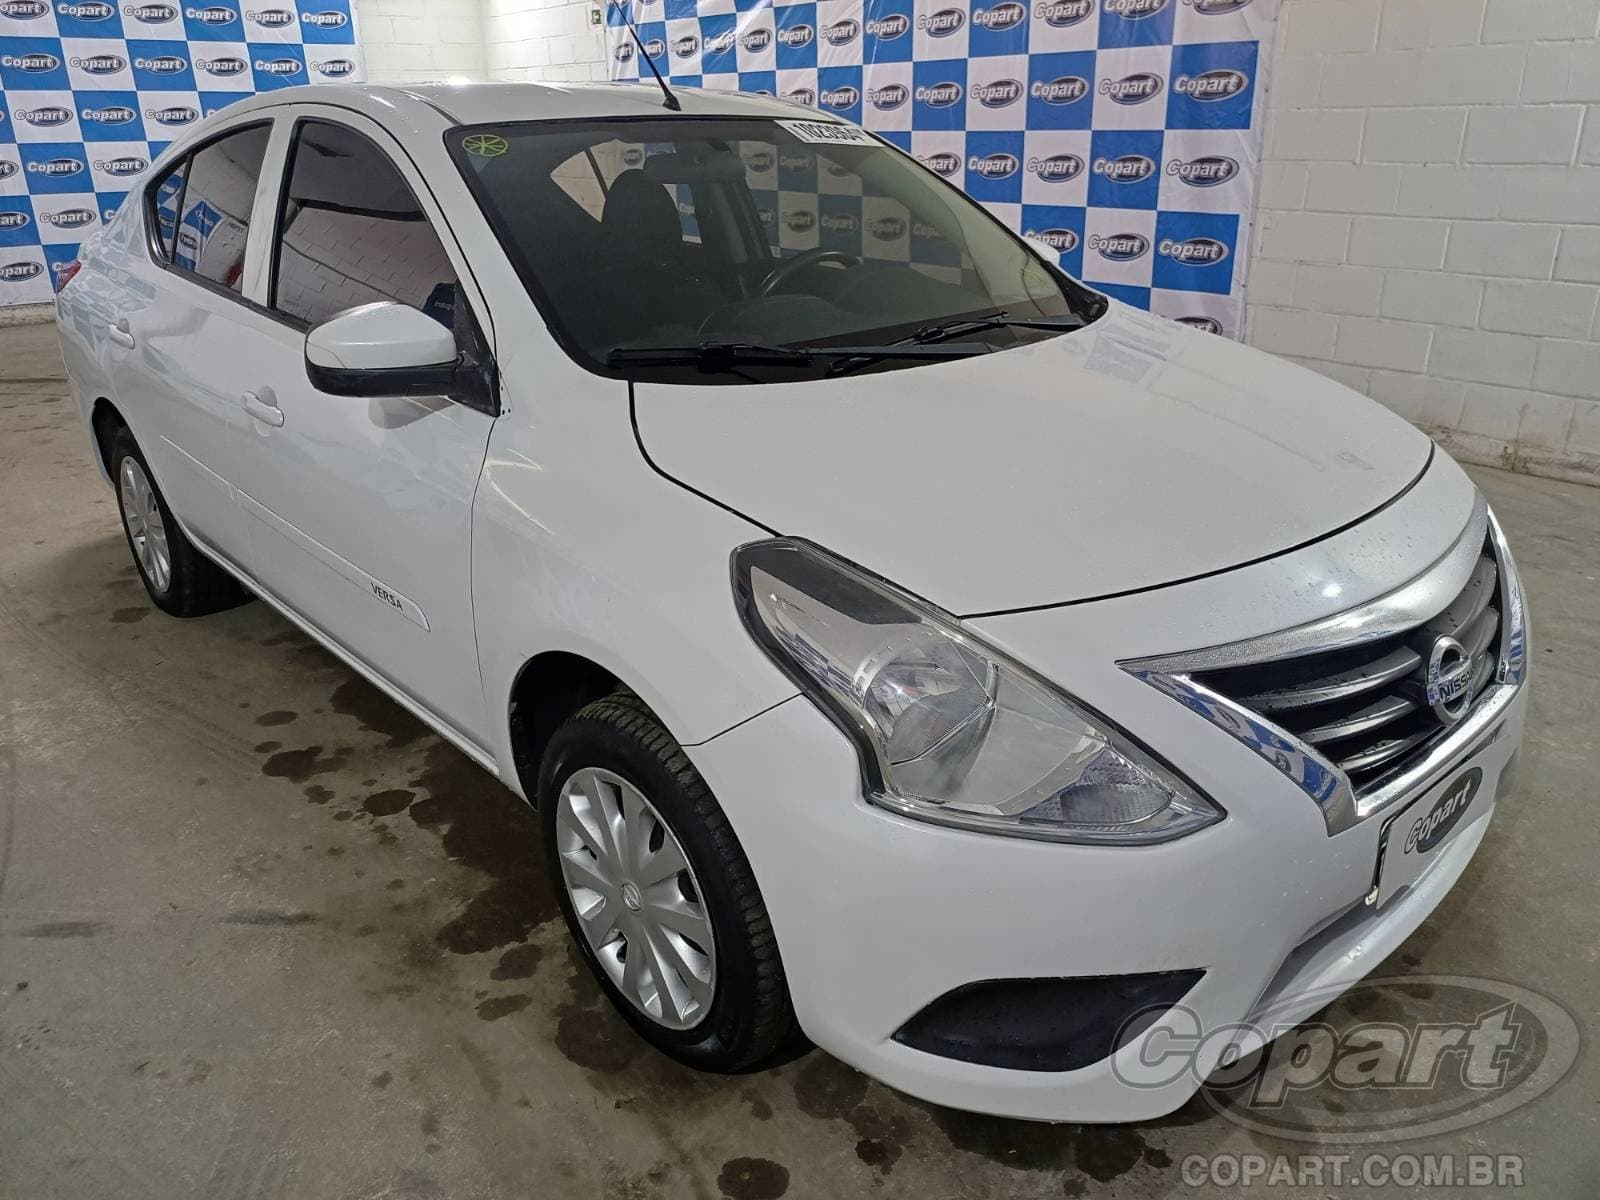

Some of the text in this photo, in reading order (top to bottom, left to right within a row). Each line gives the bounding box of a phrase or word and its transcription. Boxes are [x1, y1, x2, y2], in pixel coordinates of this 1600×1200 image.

[0, 3, 40, 14] opart
[58, 4, 108, 17] Copart
[124, 5, 171, 18] Copart
[185, 8, 231, 21] Copart
[1034, 0, 1088, 20] Copart
[1104, 0, 1160, 16] Copart
[246, 10, 288, 23] Copart
[301, 12, 343, 24] Copart
[917, 12, 959, 33] Copart
[973, 6, 1020, 27] Copart
[820, 22, 857, 41] Copart
[866, 18, 905, 35] Copart
[738, 31, 768, 47] Copart
[777, 27, 809, 43] Copart
[2, 56, 53, 69] Copart
[70, 57, 120, 70] Copart
[135, 58, 182, 71] Copart
[196, 59, 243, 72] Copart
[255, 60, 298, 73] Copart
[310, 61, 351, 73] Copart
[1031, 78, 1083, 100] Copart
[1099, 76, 1154, 99] Copart
[1174, 72, 1240, 96] Copart
[820, 89, 857, 105] Copart
[865, 87, 905, 105] Copart
[915, 84, 957, 104] Copart
[971, 82, 1016, 103] Copart
[14, 110, 66, 122] Copart
[81, 109, 130, 122] Copart
[145, 108, 194, 121] Copart
[27, 162, 78, 174] Copart
[93, 160, 142, 173] Copart
[968, 156, 1013, 175] Copart
[1027, 157, 1076, 176] Copart
[1093, 157, 1147, 177] Copart
[1166, 159, 1229, 180] Copart
[0, 214, 24, 225] art
[40, 212, 89, 224] Copart
[1088, 234, 1143, 253] Copart
[1158, 238, 1219, 260] Copart
[370, 582, 404, 611] VERSA
[1438, 669, 1473, 700] NISSA
[1404, 777, 1472, 855] Copart
